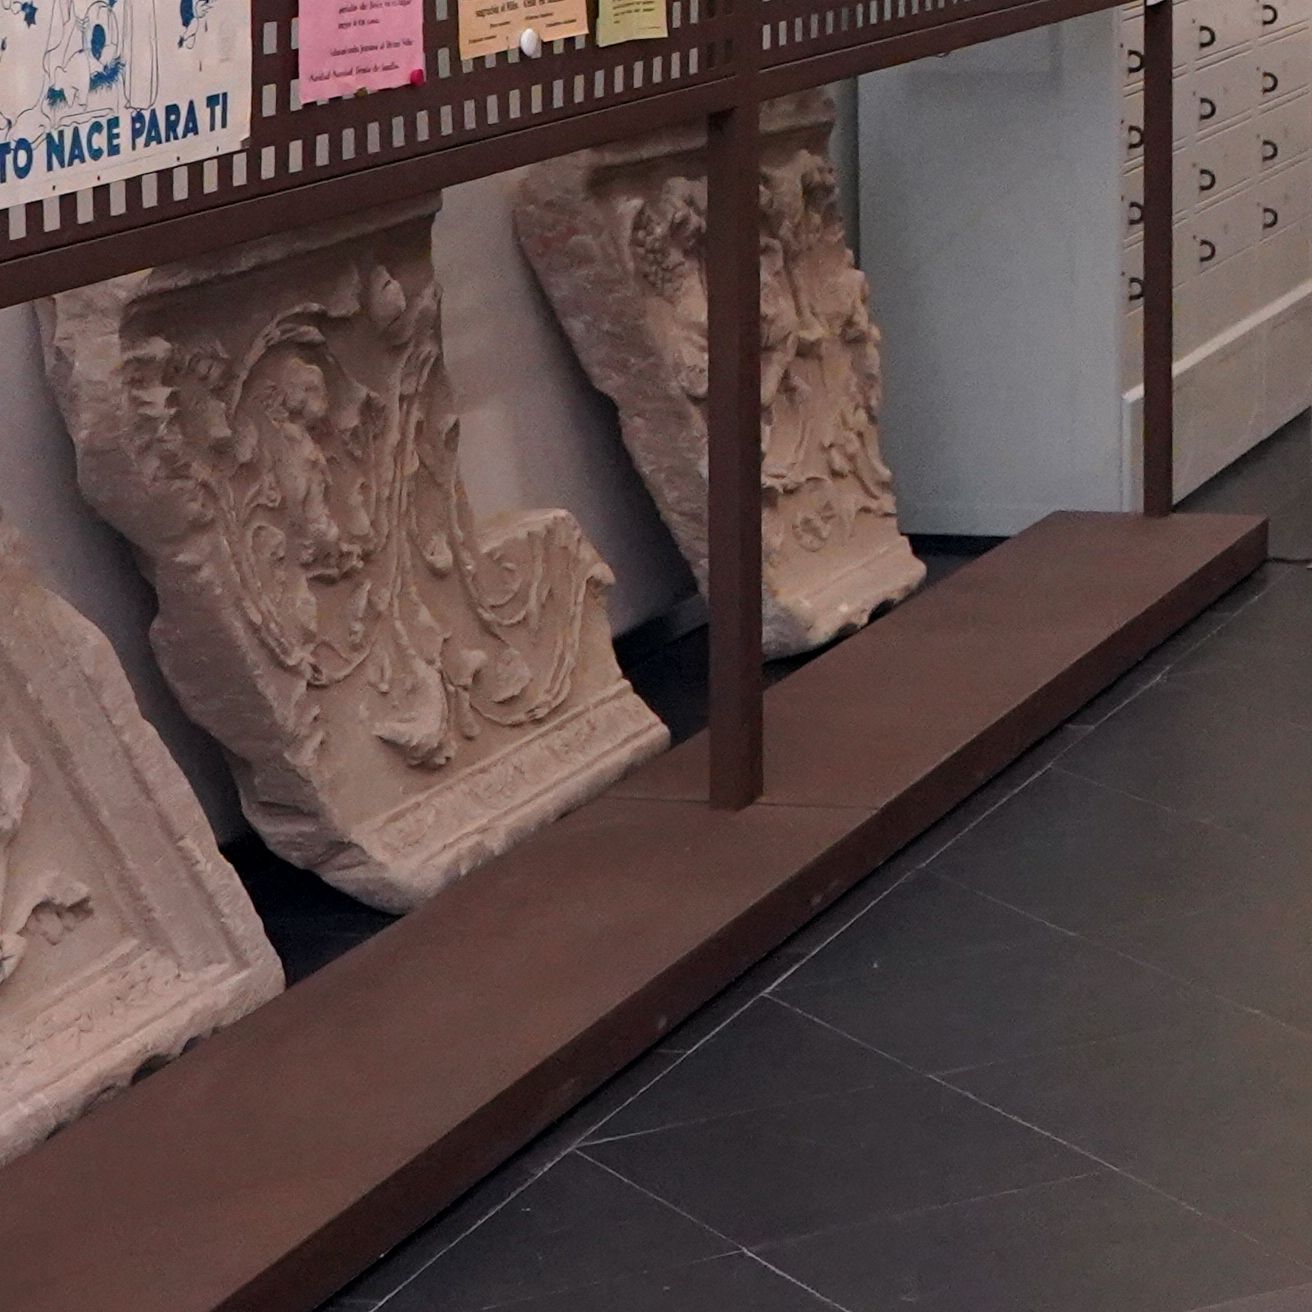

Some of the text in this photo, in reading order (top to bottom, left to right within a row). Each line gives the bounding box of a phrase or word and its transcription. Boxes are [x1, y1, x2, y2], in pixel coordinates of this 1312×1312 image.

[0, 92, 228, 184] TO NACE PARA TI
